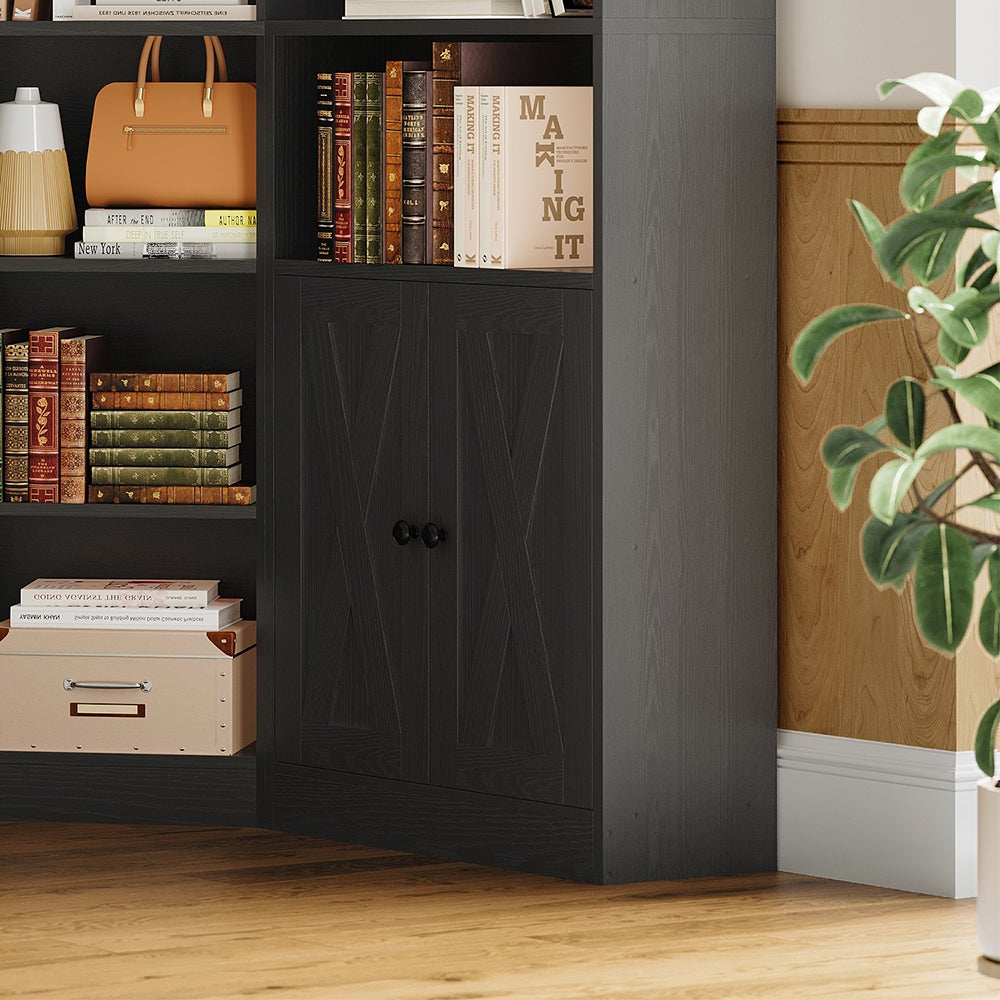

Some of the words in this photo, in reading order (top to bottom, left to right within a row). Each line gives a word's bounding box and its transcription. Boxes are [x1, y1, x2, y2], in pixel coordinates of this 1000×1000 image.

[467, 95, 475, 140] MAKING
[492, 95, 501, 140] MAKING
[467, 143, 475, 155] IT
[492, 143, 501, 155] IT
[107, 214, 127, 225] AFTER
[140, 214, 154, 226] END
[218, 215, 244, 226] AUTHOR
[78, 243, 98, 255] New
[100, 242, 121, 255] York
[554, 234, 584, 260] IT
